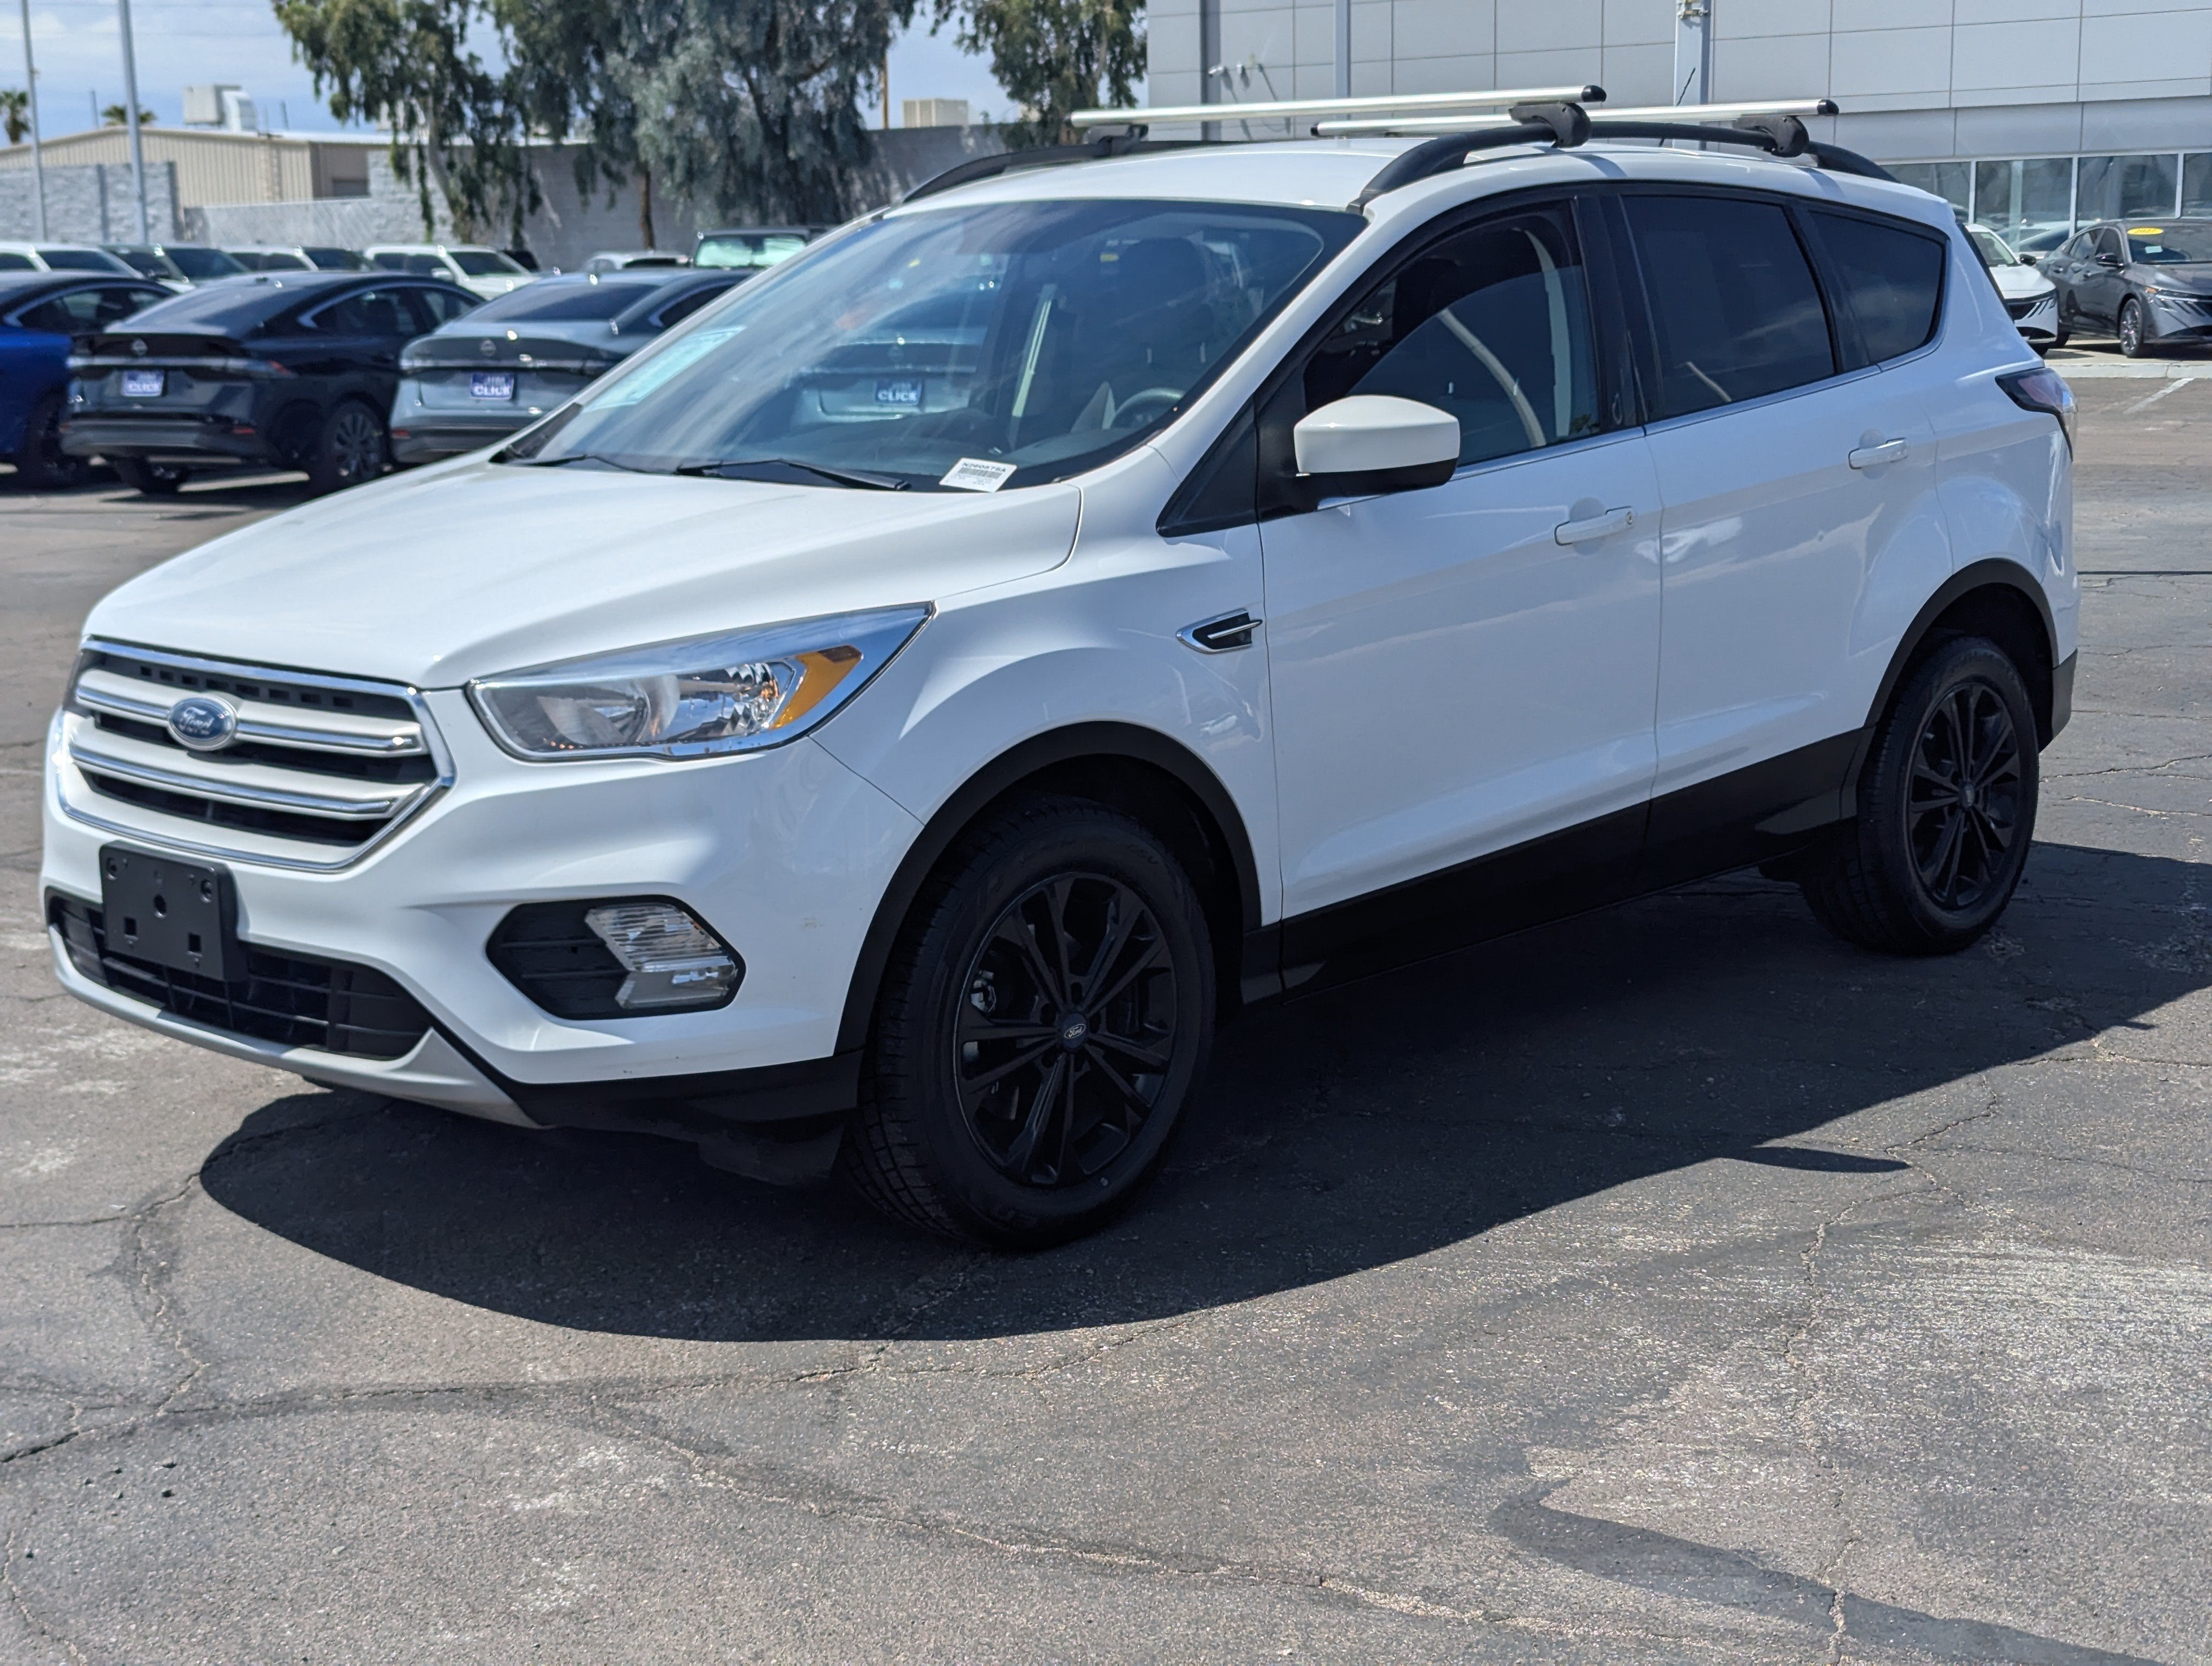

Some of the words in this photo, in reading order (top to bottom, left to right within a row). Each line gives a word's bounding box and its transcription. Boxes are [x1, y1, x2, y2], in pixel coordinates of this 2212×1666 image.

[473, 384, 511, 396] CLICK
[878, 390, 917, 401] CLICK
[179, 707, 215, 735] Ford
[1068, 1026, 1082, 1037] Ford
